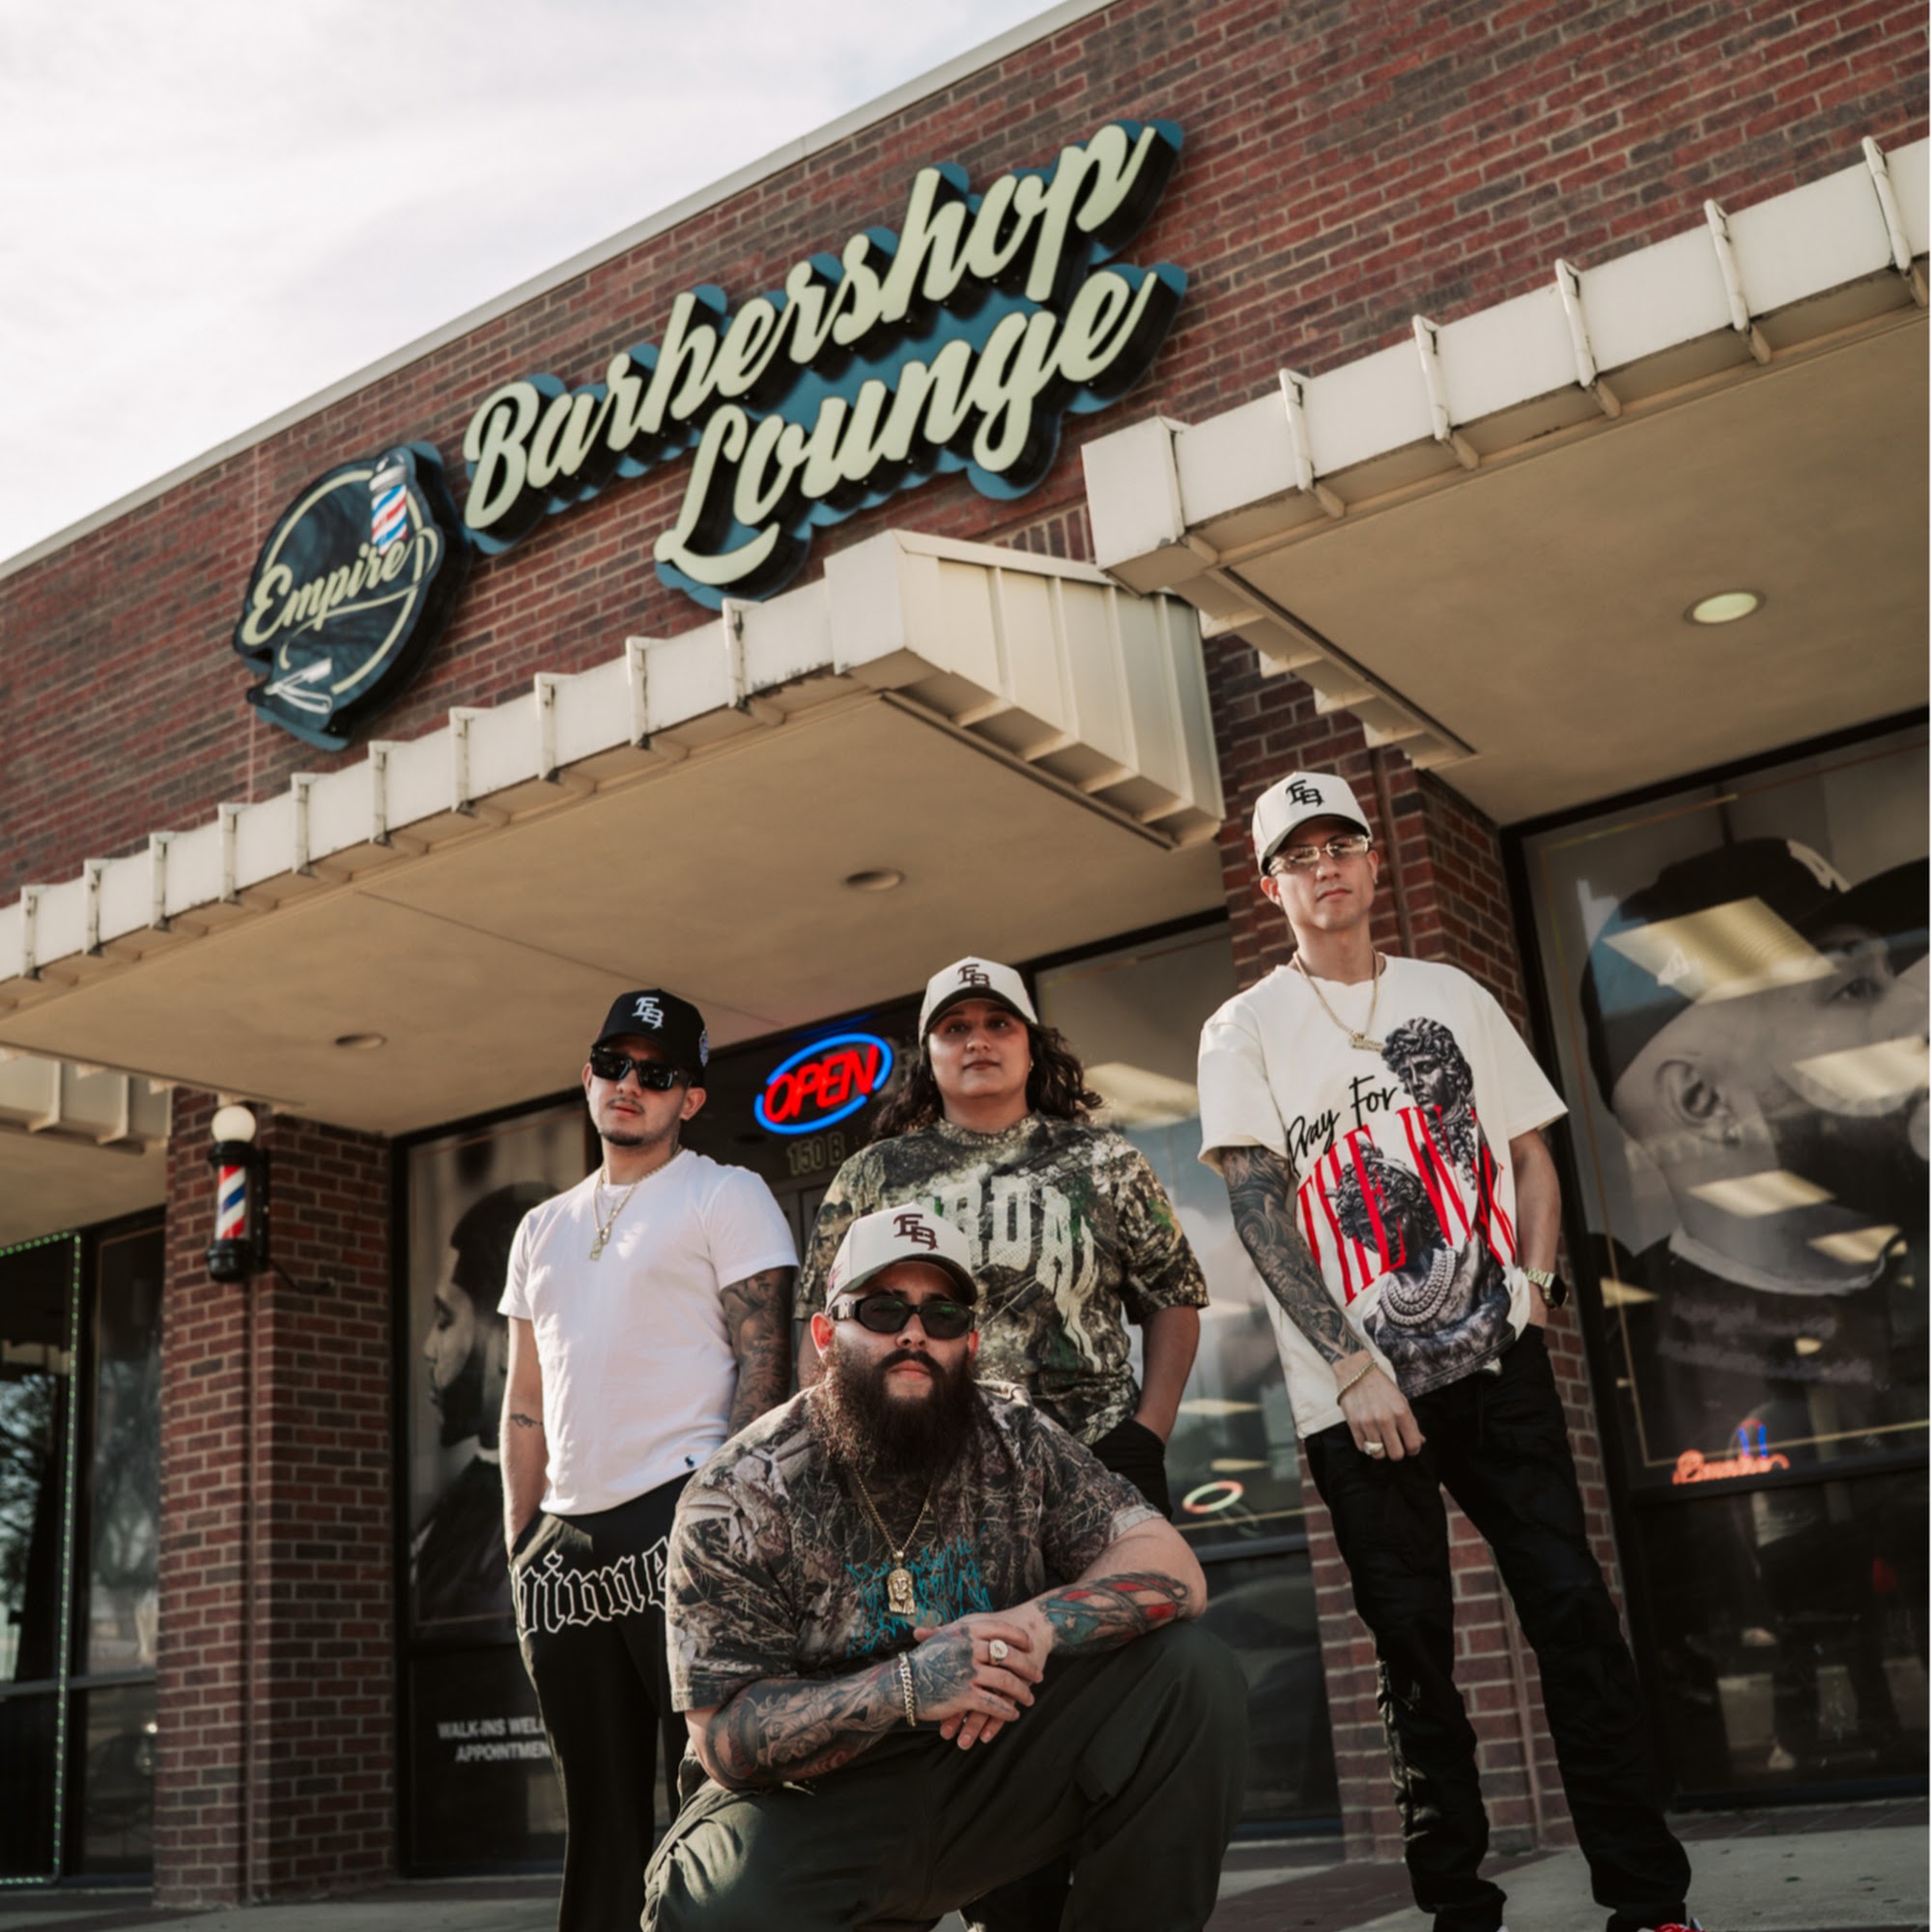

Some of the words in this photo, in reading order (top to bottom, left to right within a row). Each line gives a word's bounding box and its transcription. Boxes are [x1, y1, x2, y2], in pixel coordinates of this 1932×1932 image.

[654, 270, 1156, 585] Lounge
[242, 537, 415, 646] Empire
[763, 1043, 879, 1123] OPEN
[1349, 1074, 1398, 1130] For
[437, 1718, 506, 1740] WALK-INS
[507, 1716, 544, 1736] WEL
